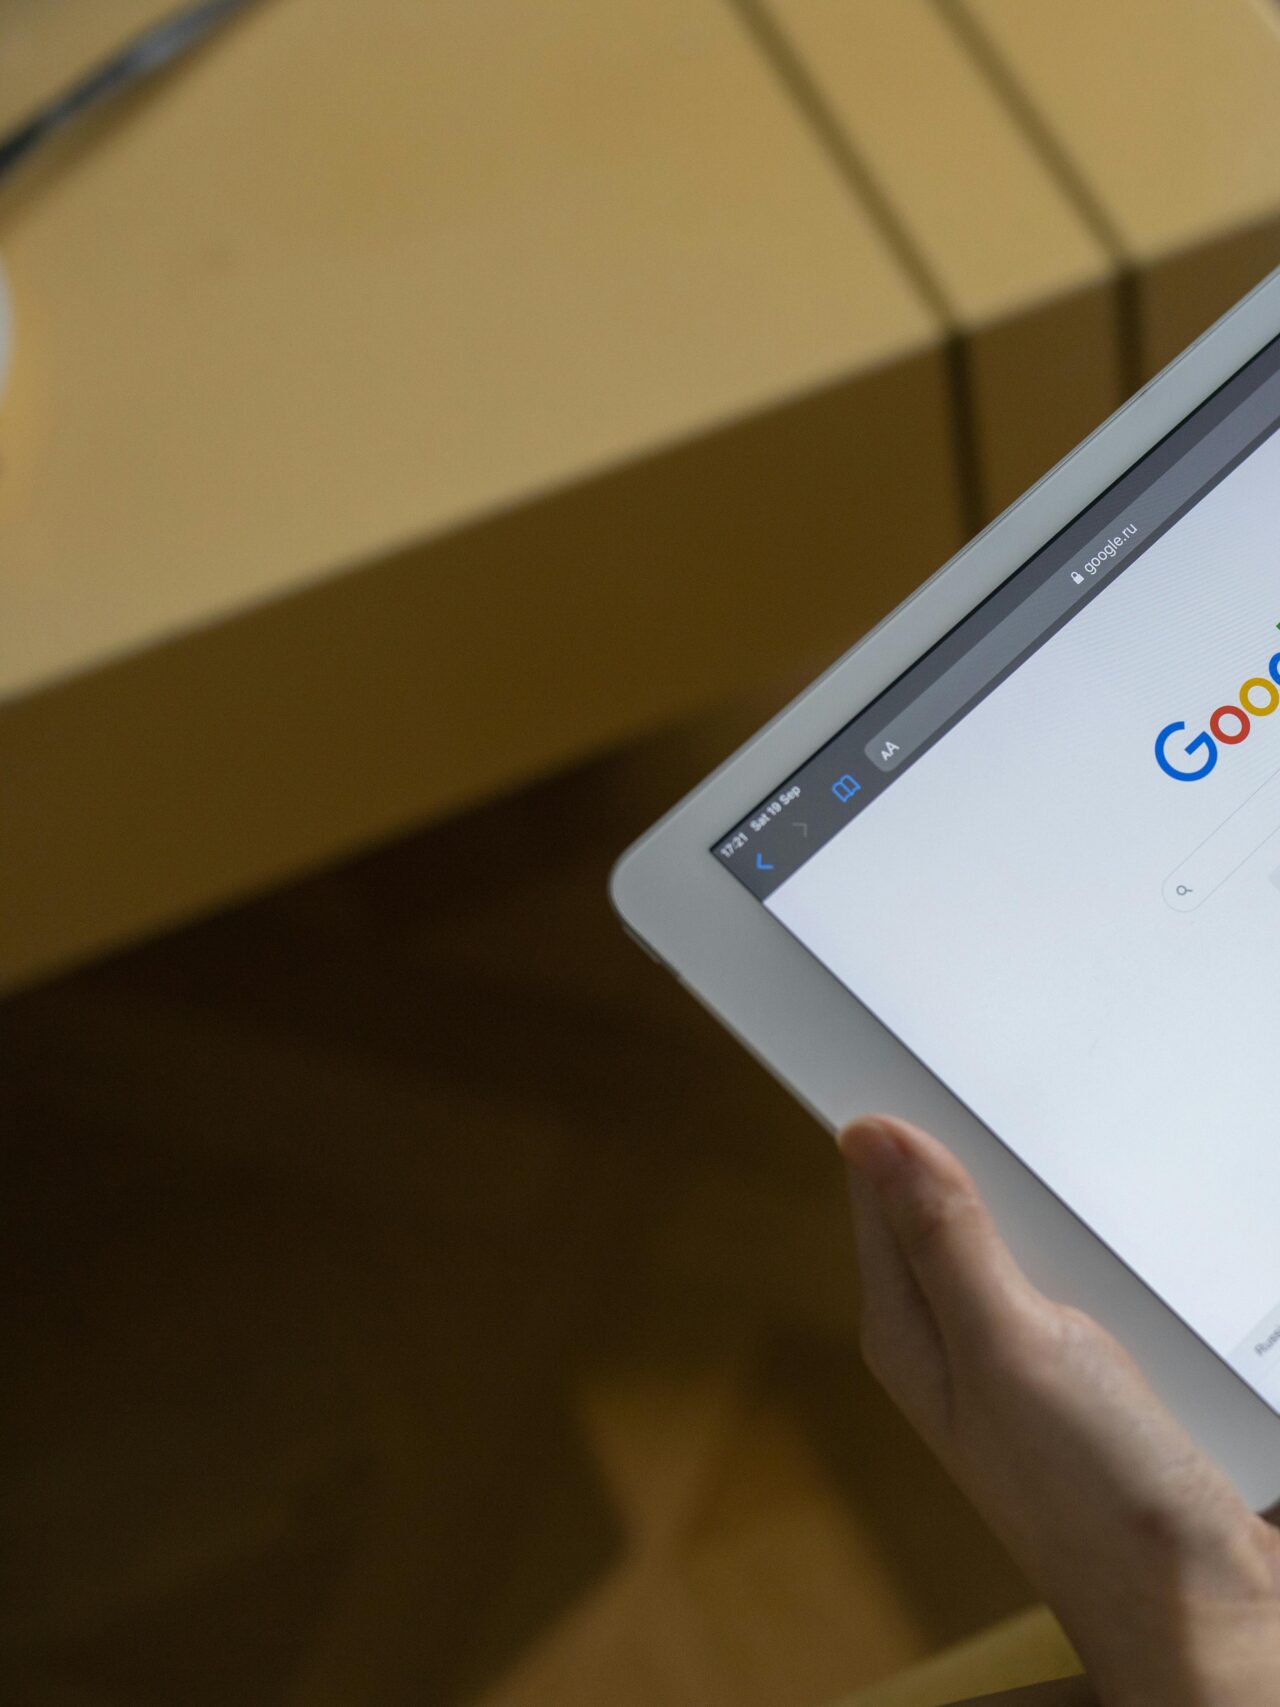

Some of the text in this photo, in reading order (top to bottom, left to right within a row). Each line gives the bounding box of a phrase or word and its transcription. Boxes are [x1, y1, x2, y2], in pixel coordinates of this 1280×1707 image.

[1084, 523, 1138, 575] google.ru
[749, 786, 801, 832] Sat 19 Sep
[720, 832, 749, 858] 17:21
